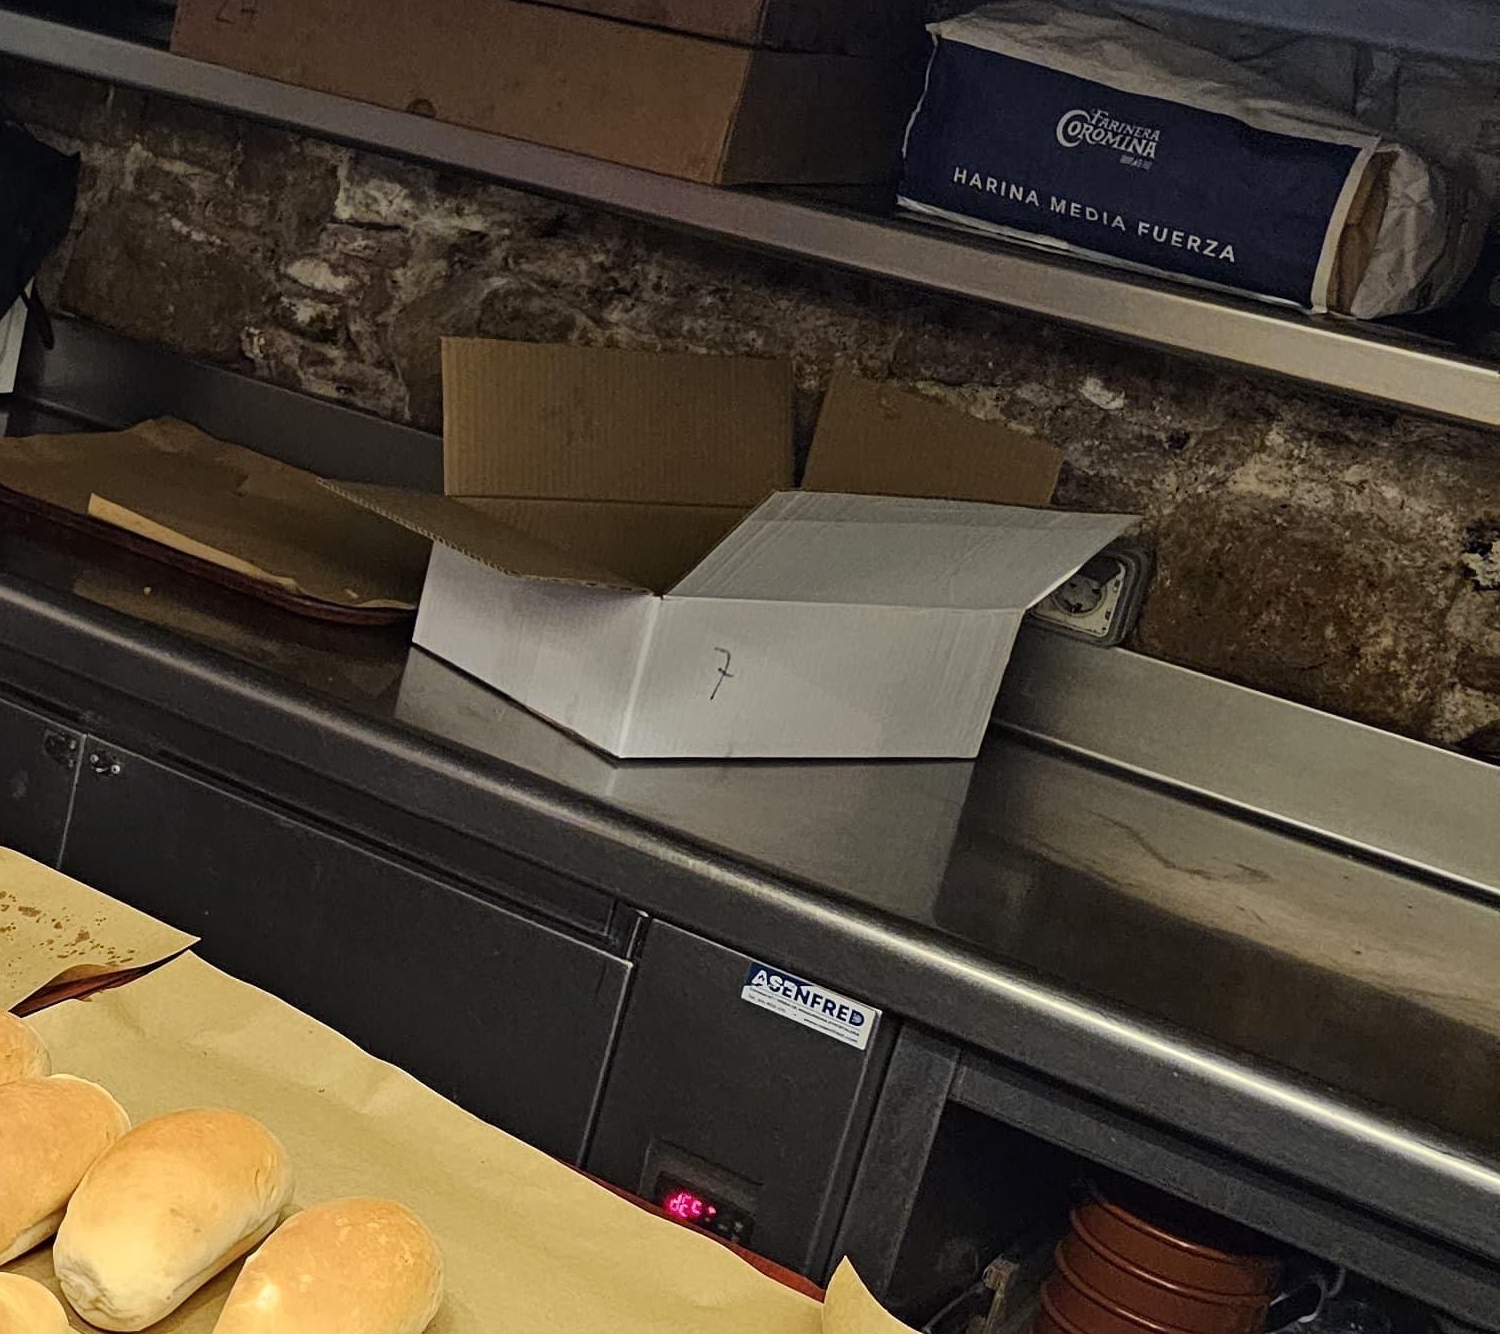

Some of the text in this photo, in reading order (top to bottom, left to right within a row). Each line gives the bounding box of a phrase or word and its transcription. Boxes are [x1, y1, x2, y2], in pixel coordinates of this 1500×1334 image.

[1056, 109, 1158, 159] COROMINA
[1091, 108, 1161, 142] FARINERA
[953, 167, 1236, 262] HARINA MEDIA FUERZA
[751, 969, 865, 1027] ASENFRED
